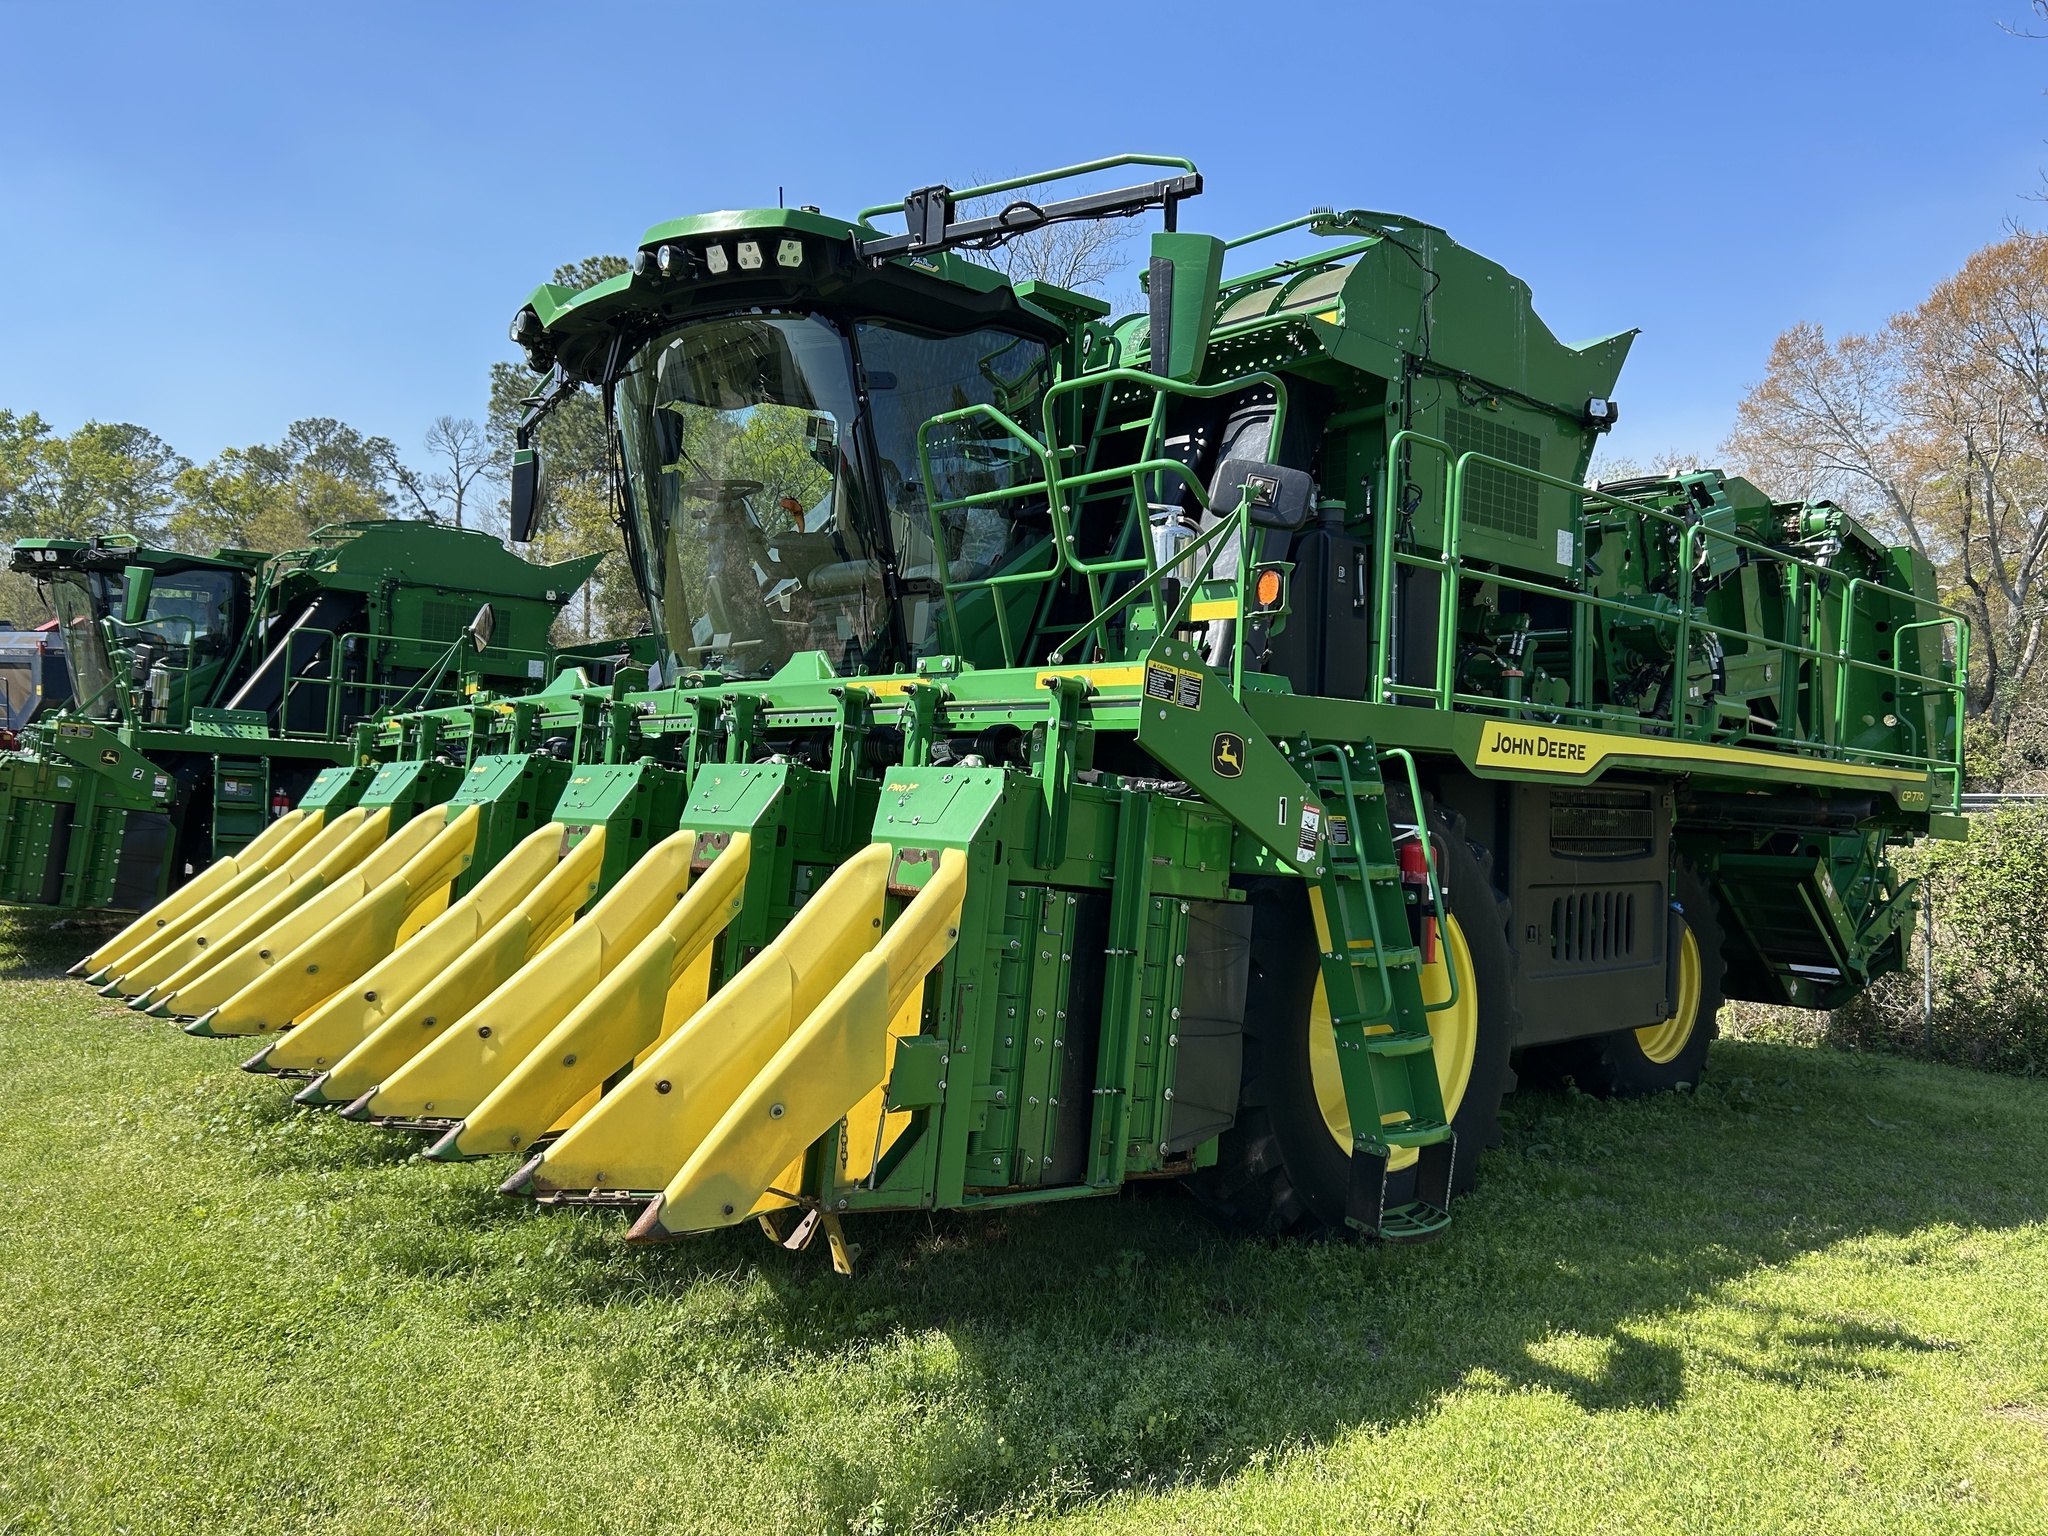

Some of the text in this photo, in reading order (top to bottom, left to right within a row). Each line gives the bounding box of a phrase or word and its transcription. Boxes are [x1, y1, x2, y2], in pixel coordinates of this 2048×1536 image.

[1156, 663, 1174, 673] CAUTION
[1491, 732, 1586, 761] JOHN DEERE
[133, 769, 143, 779] 2
[886, 783, 906, 792] PRO
[1902, 791, 1925, 802] CP 770
[1280, 798, 1286, 824] 1
